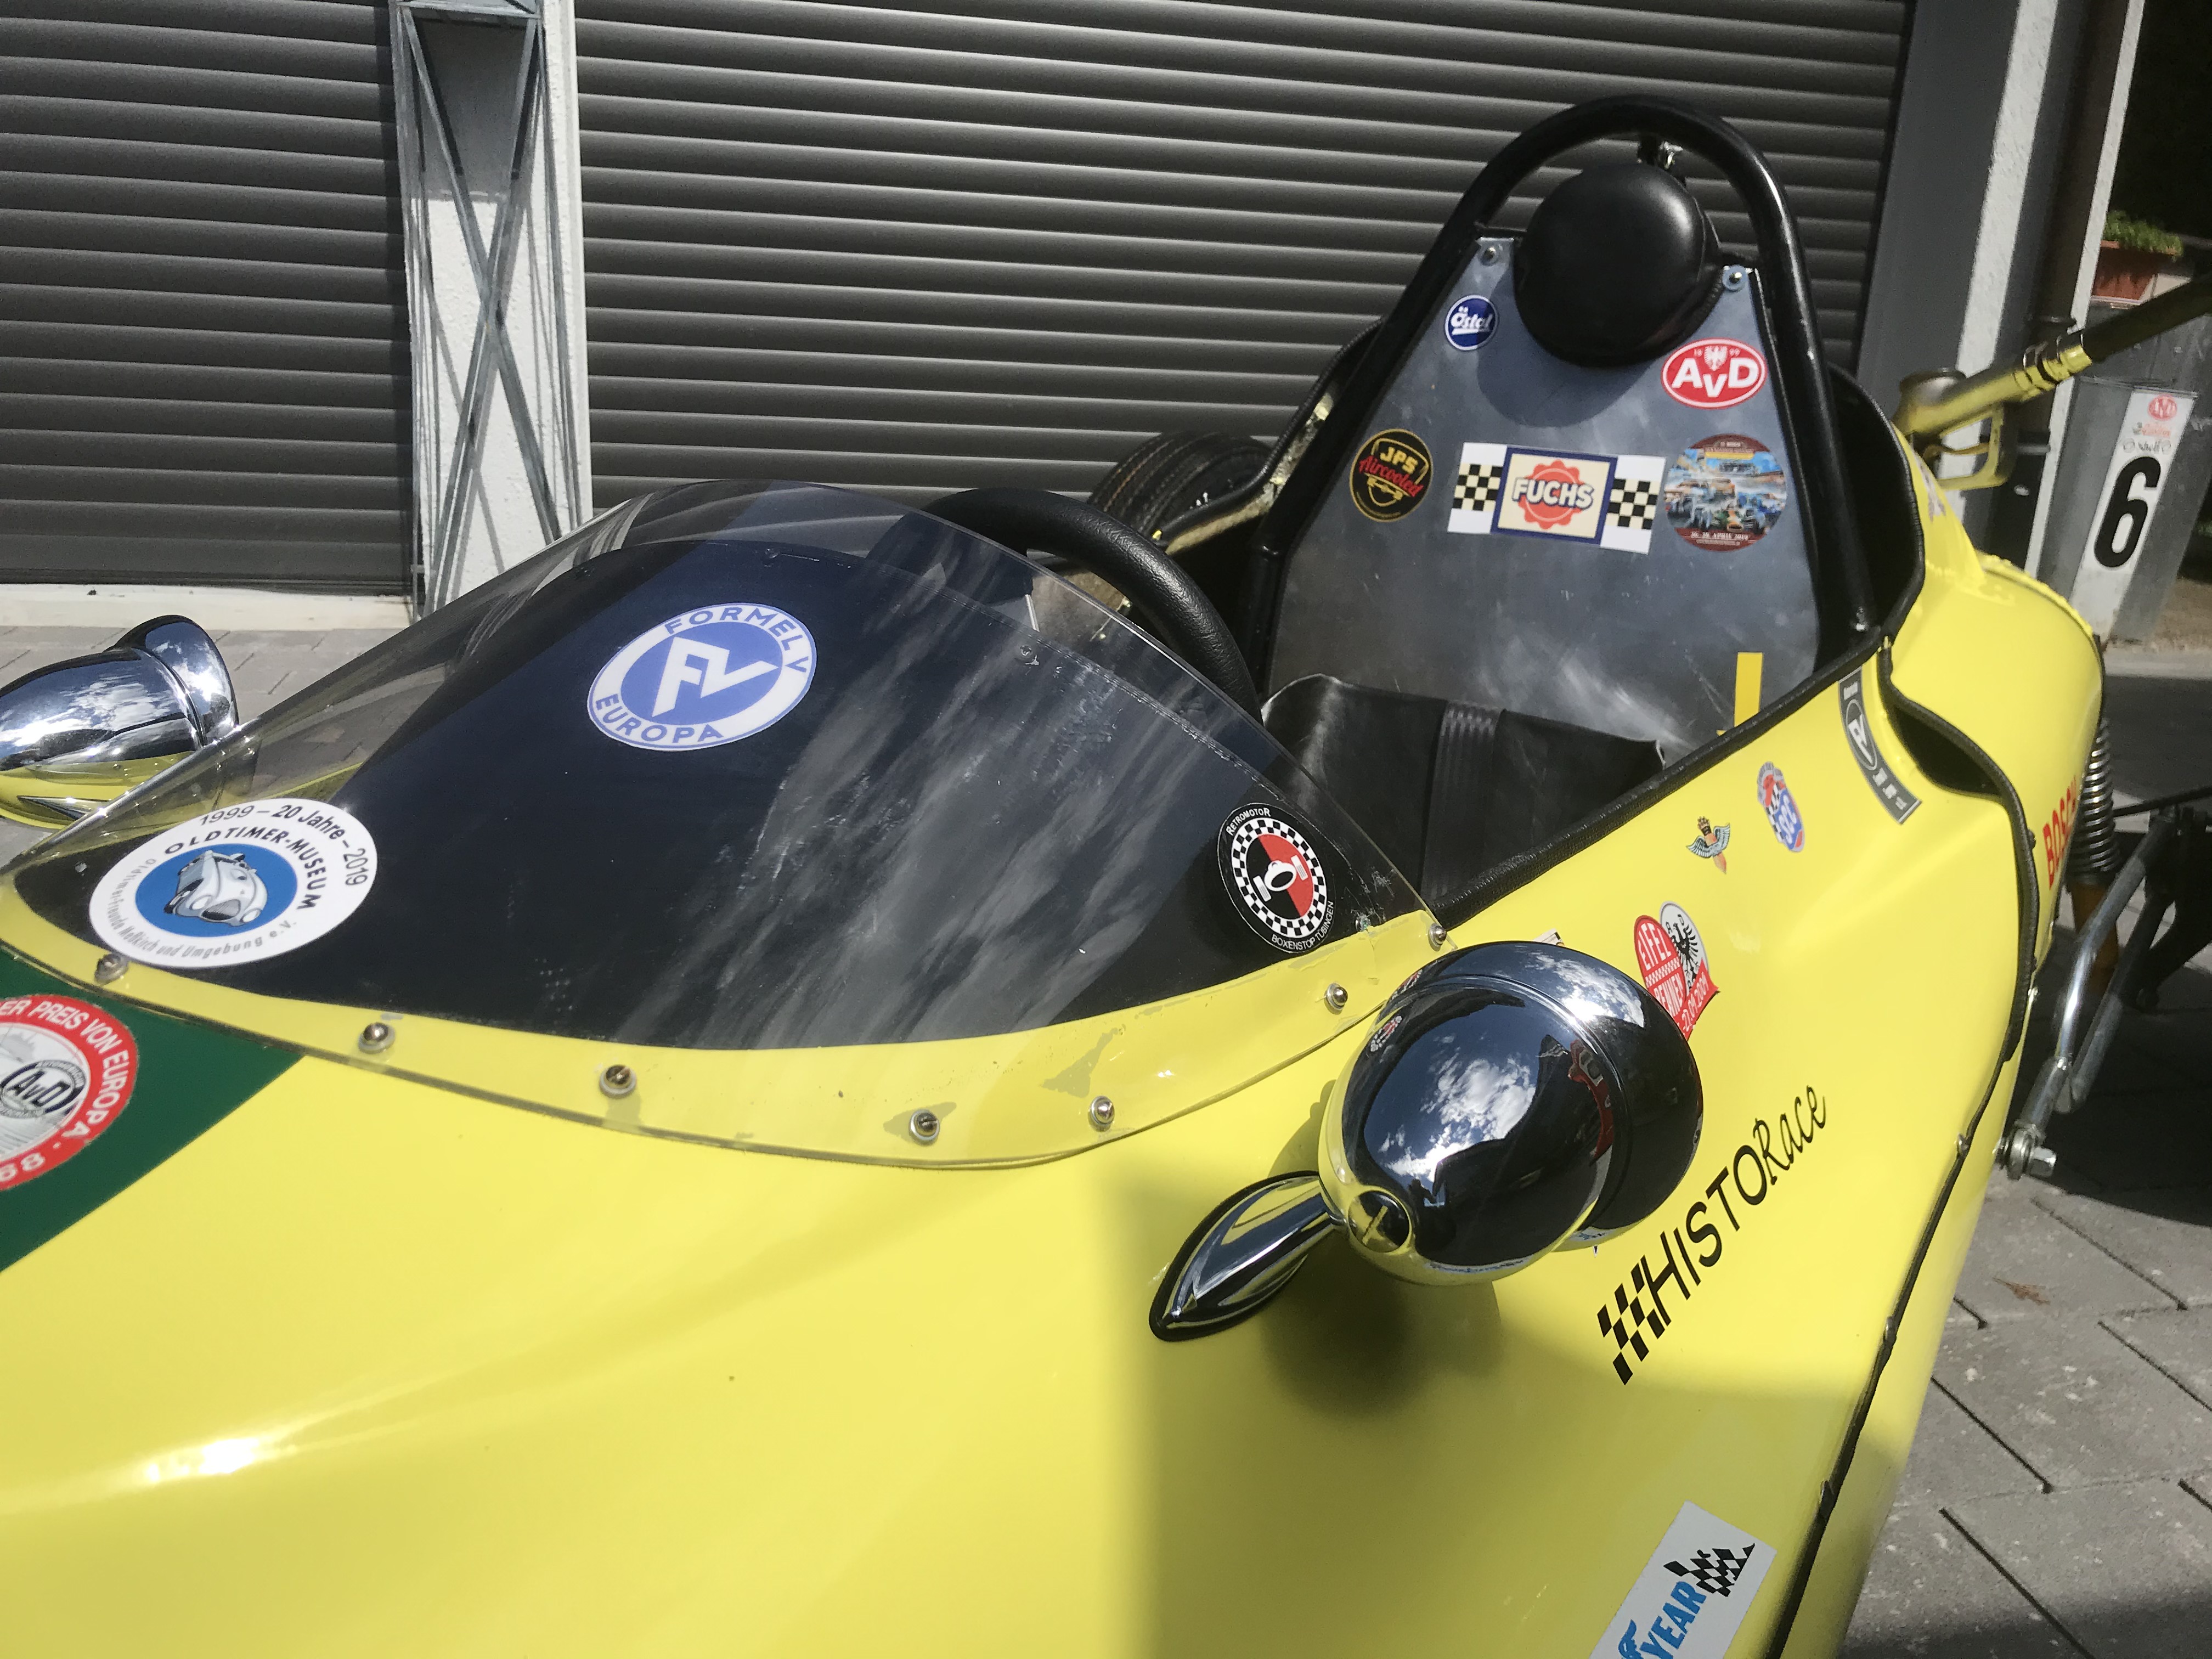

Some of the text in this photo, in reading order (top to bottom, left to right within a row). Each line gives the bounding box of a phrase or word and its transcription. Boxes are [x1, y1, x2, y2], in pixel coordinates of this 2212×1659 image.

[1672, 358, 1759, 398] AvD
[1380, 447, 1418, 474] JPS
[1513, 477, 1594, 510] FUCHS
[2094, 456, 2161, 568] 6
[596, 693, 724, 743] EUROPA
[1226, 808, 1271, 836] RETROMOTOR
[200, 804, 368, 885] 1999 20 Jahre 2019
[1272, 901, 1334, 950] BOXENSTOP TÜBINGEN
[156, 944, 184, 956] und
[182, 936, 263, 959] Umgebung
[1637, 922, 1672, 971] EIFEL
[27, 1000, 90, 1030] PREIS
[80, 1018, 123, 1054] VON
[7, 1071, 71, 1107] AvD
[61, 1049, 130, 1138] EUROPA
